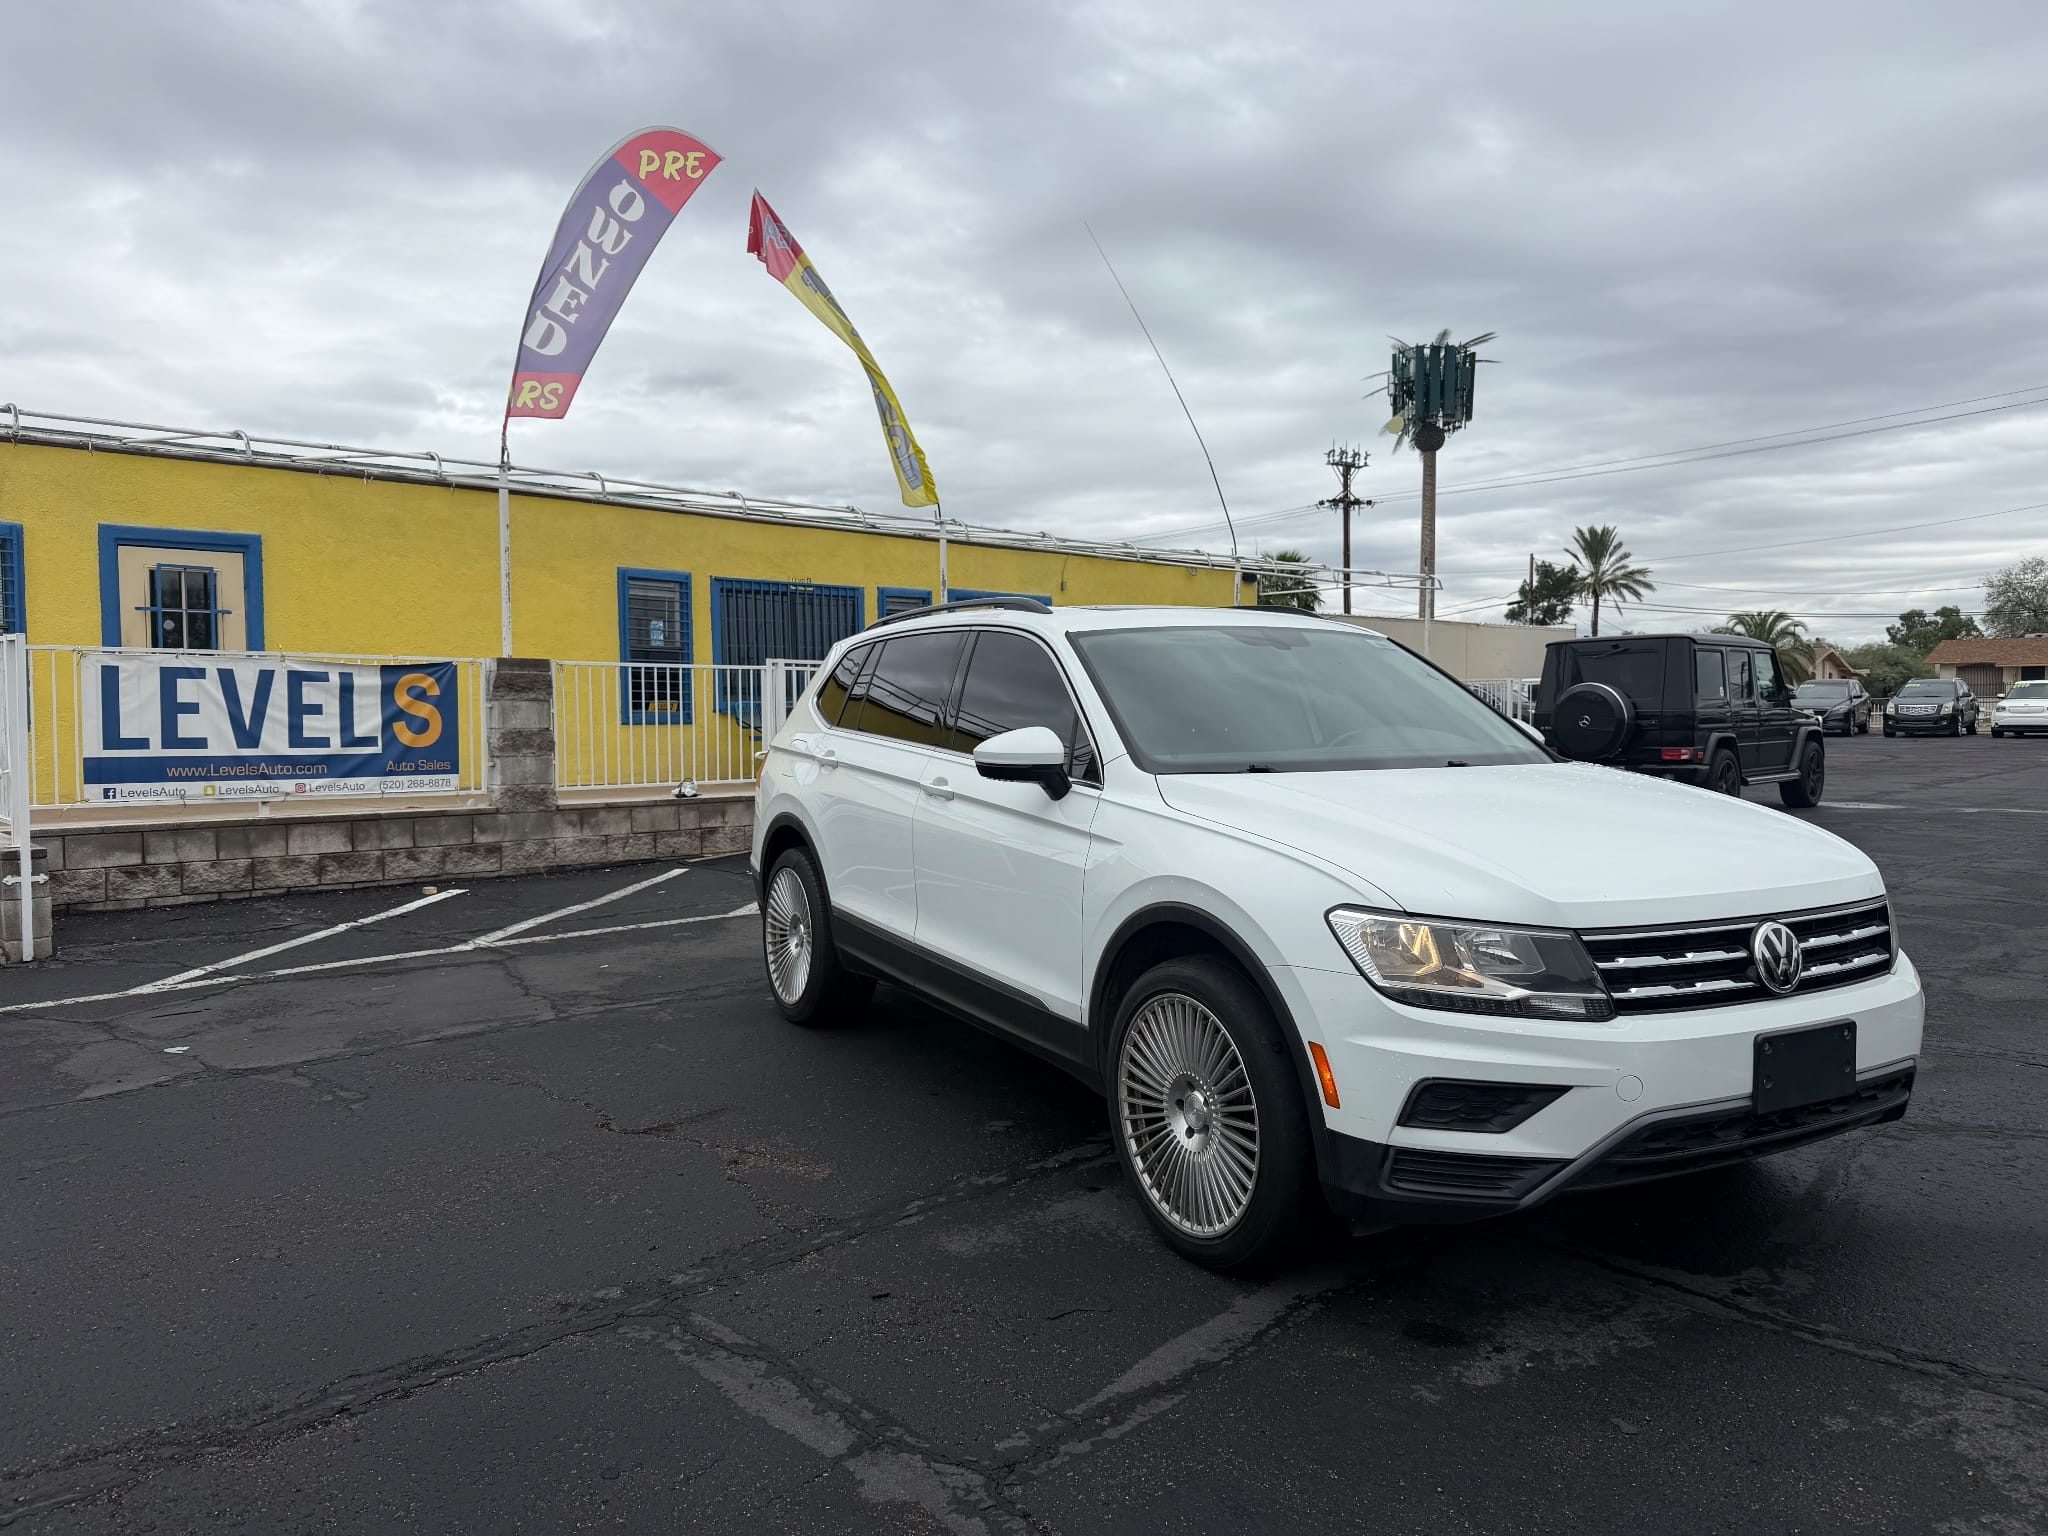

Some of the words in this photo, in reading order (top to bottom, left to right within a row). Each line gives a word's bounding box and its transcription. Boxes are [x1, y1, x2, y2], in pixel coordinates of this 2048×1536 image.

[638, 149, 706, 181] PRE
[523, 178, 645, 356] OWNED
[100, 664, 443, 751] LEVELS
[166, 762, 328, 778] www.LevelsAuto.com
[386, 760, 415, 773] Auto
[417, 758, 452, 772] Sales
[218, 784, 280, 796] LevelsAuto
[308, 782, 366, 793] LevelsAuto
[379, 779, 405, 791] (520)
[407, 778, 452, 790] 268-8878
[120, 787, 187, 798] LevelsAuto
